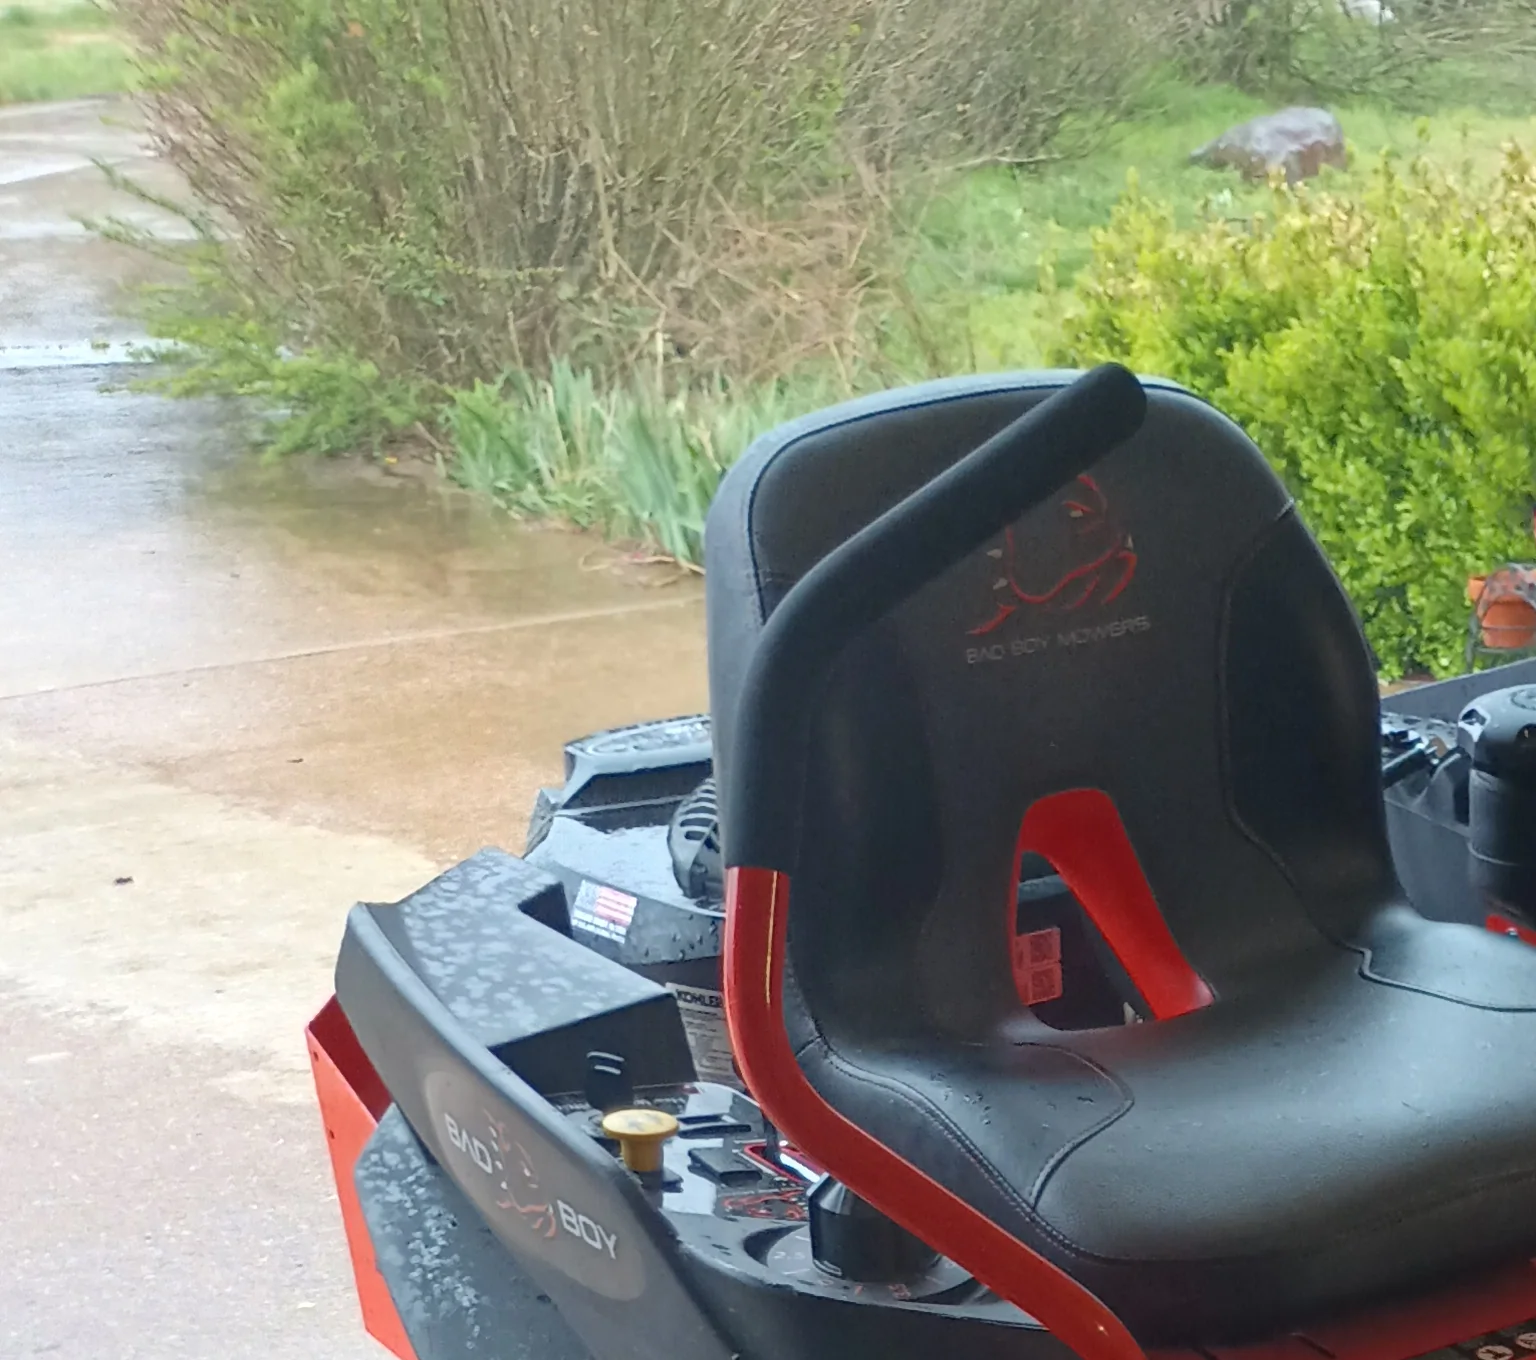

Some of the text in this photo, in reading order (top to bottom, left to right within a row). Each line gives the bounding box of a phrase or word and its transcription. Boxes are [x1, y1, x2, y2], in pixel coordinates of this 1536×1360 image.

[965, 616, 1151, 664] BAD BOY MOWERS
[444, 1112, 617, 1260] BAD BOY
